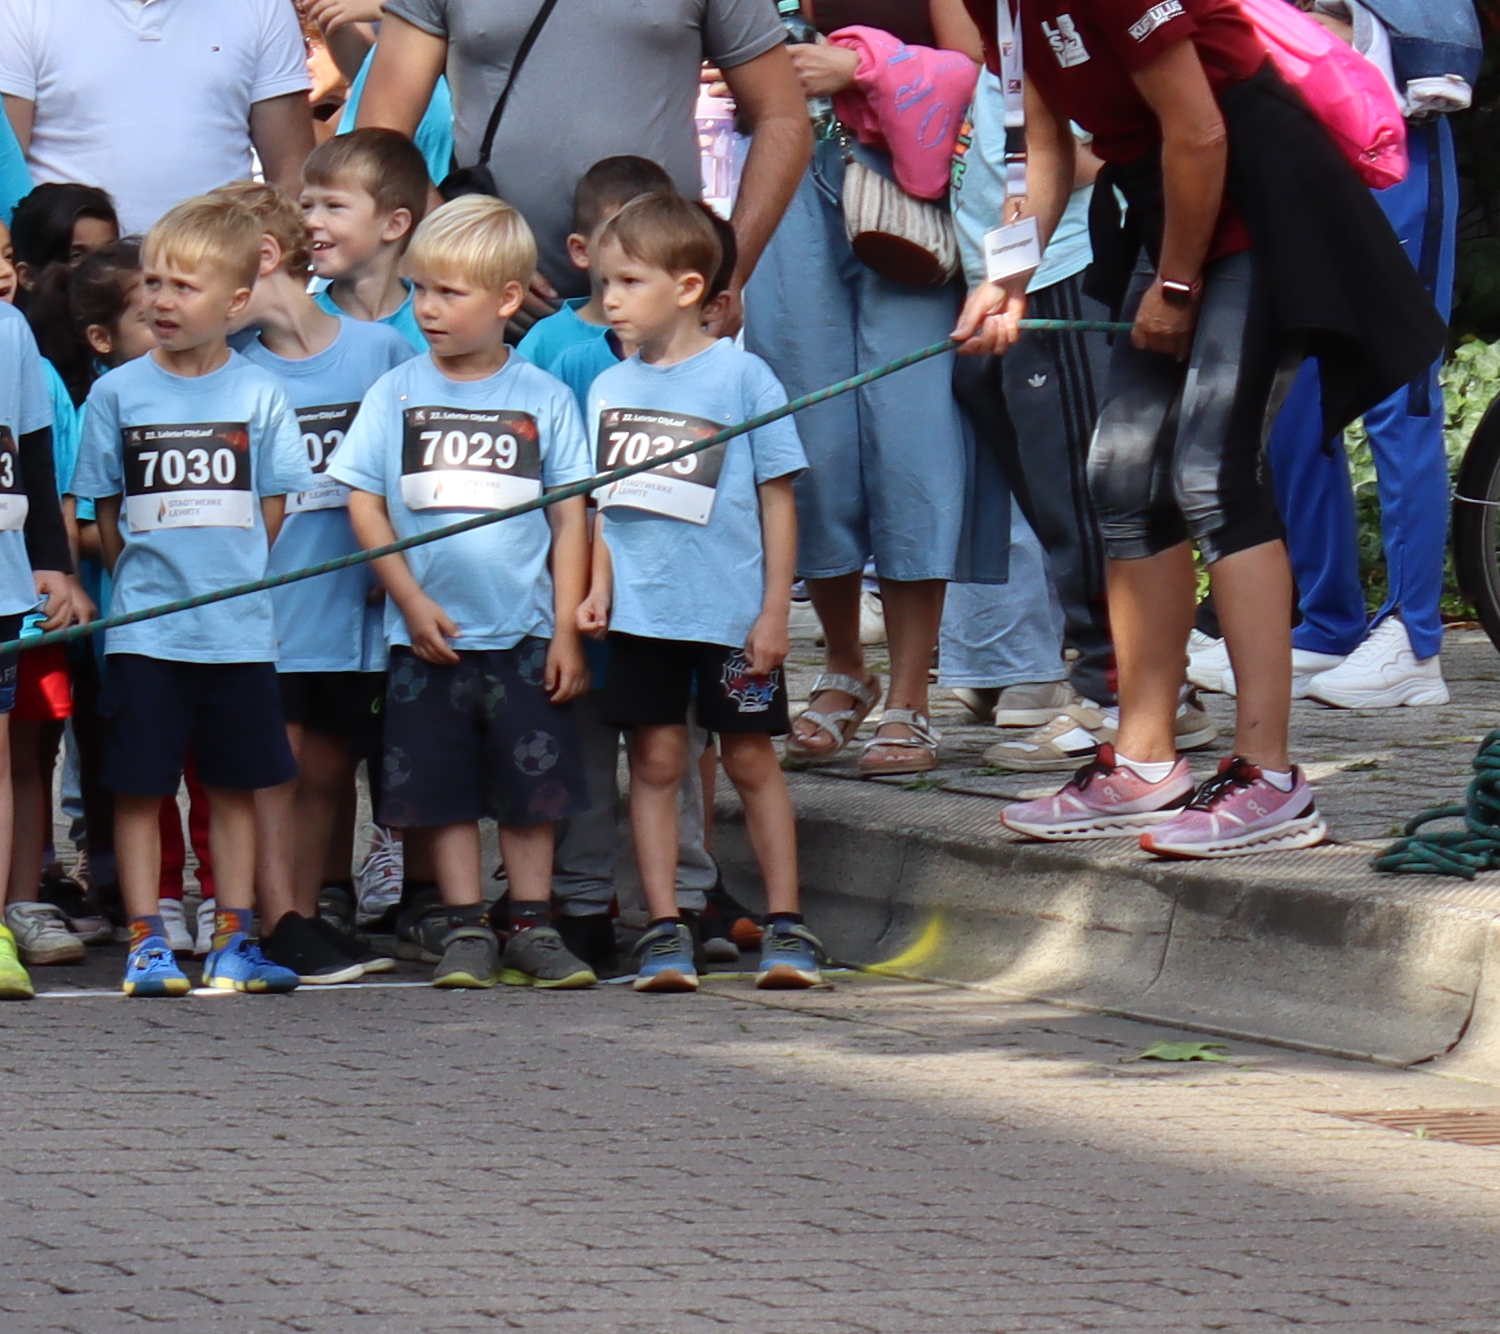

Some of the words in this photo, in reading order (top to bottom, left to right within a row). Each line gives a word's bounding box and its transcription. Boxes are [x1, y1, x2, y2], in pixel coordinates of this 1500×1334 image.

[138, 448, 236, 487] 7030
[301, 430, 346, 468] 02
[420, 431, 518, 469] 7029
[604, 431, 698, 475] 7035
[168, 498, 221, 507] STADTWERKE
[168, 507, 199, 516] LEHRTE
